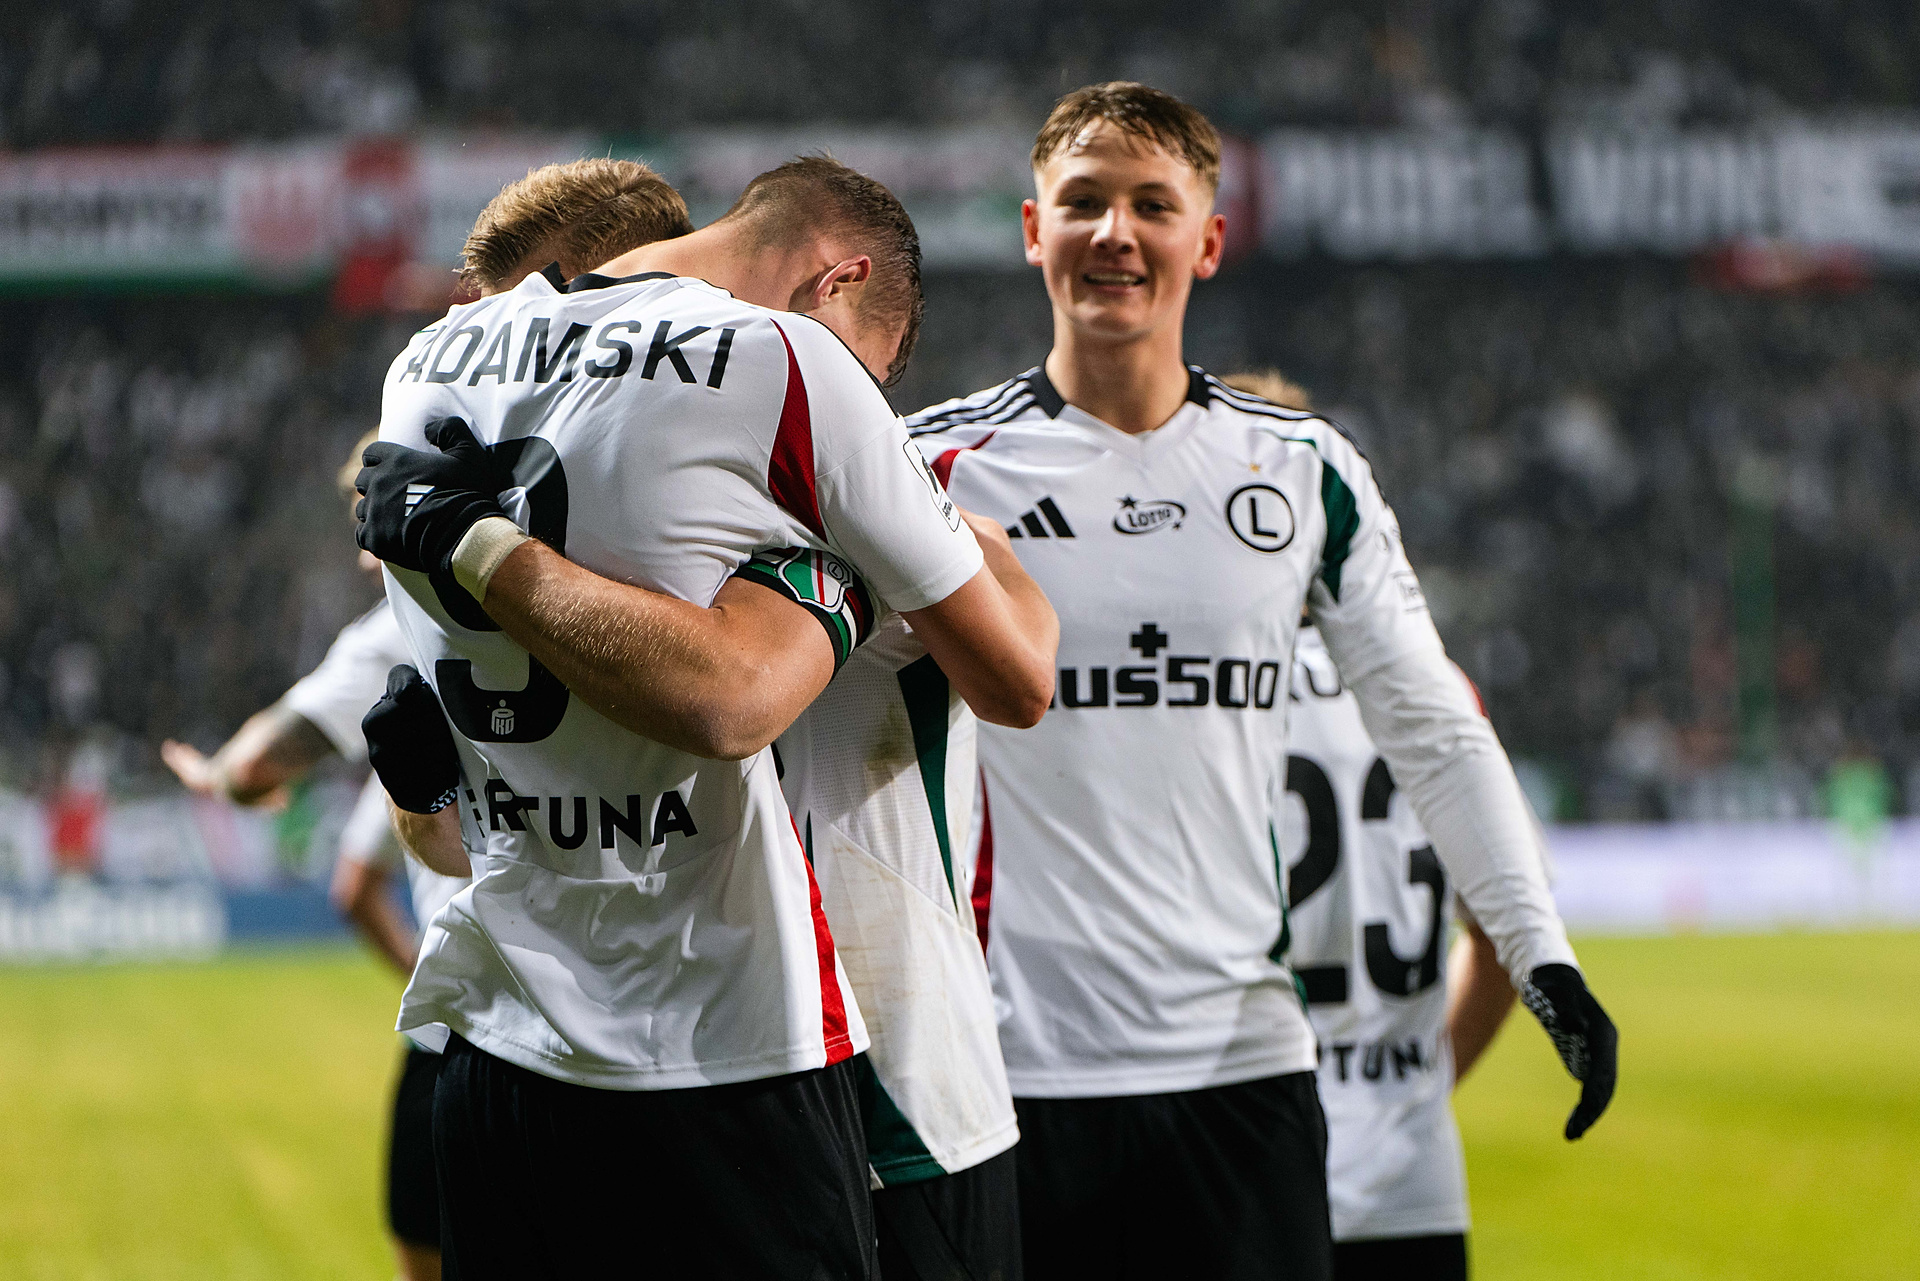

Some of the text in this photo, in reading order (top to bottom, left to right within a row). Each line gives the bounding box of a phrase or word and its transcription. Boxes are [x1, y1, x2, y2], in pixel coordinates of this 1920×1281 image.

[399, 318, 737, 390] ADAMSKI
[1249, 497, 1278, 539] L
[1049, 656, 1279, 709] us500
[465, 778, 699, 850] RTUNA
[1285, 755, 1445, 1003] 23
[1317, 1039, 1424, 1083] TUN
